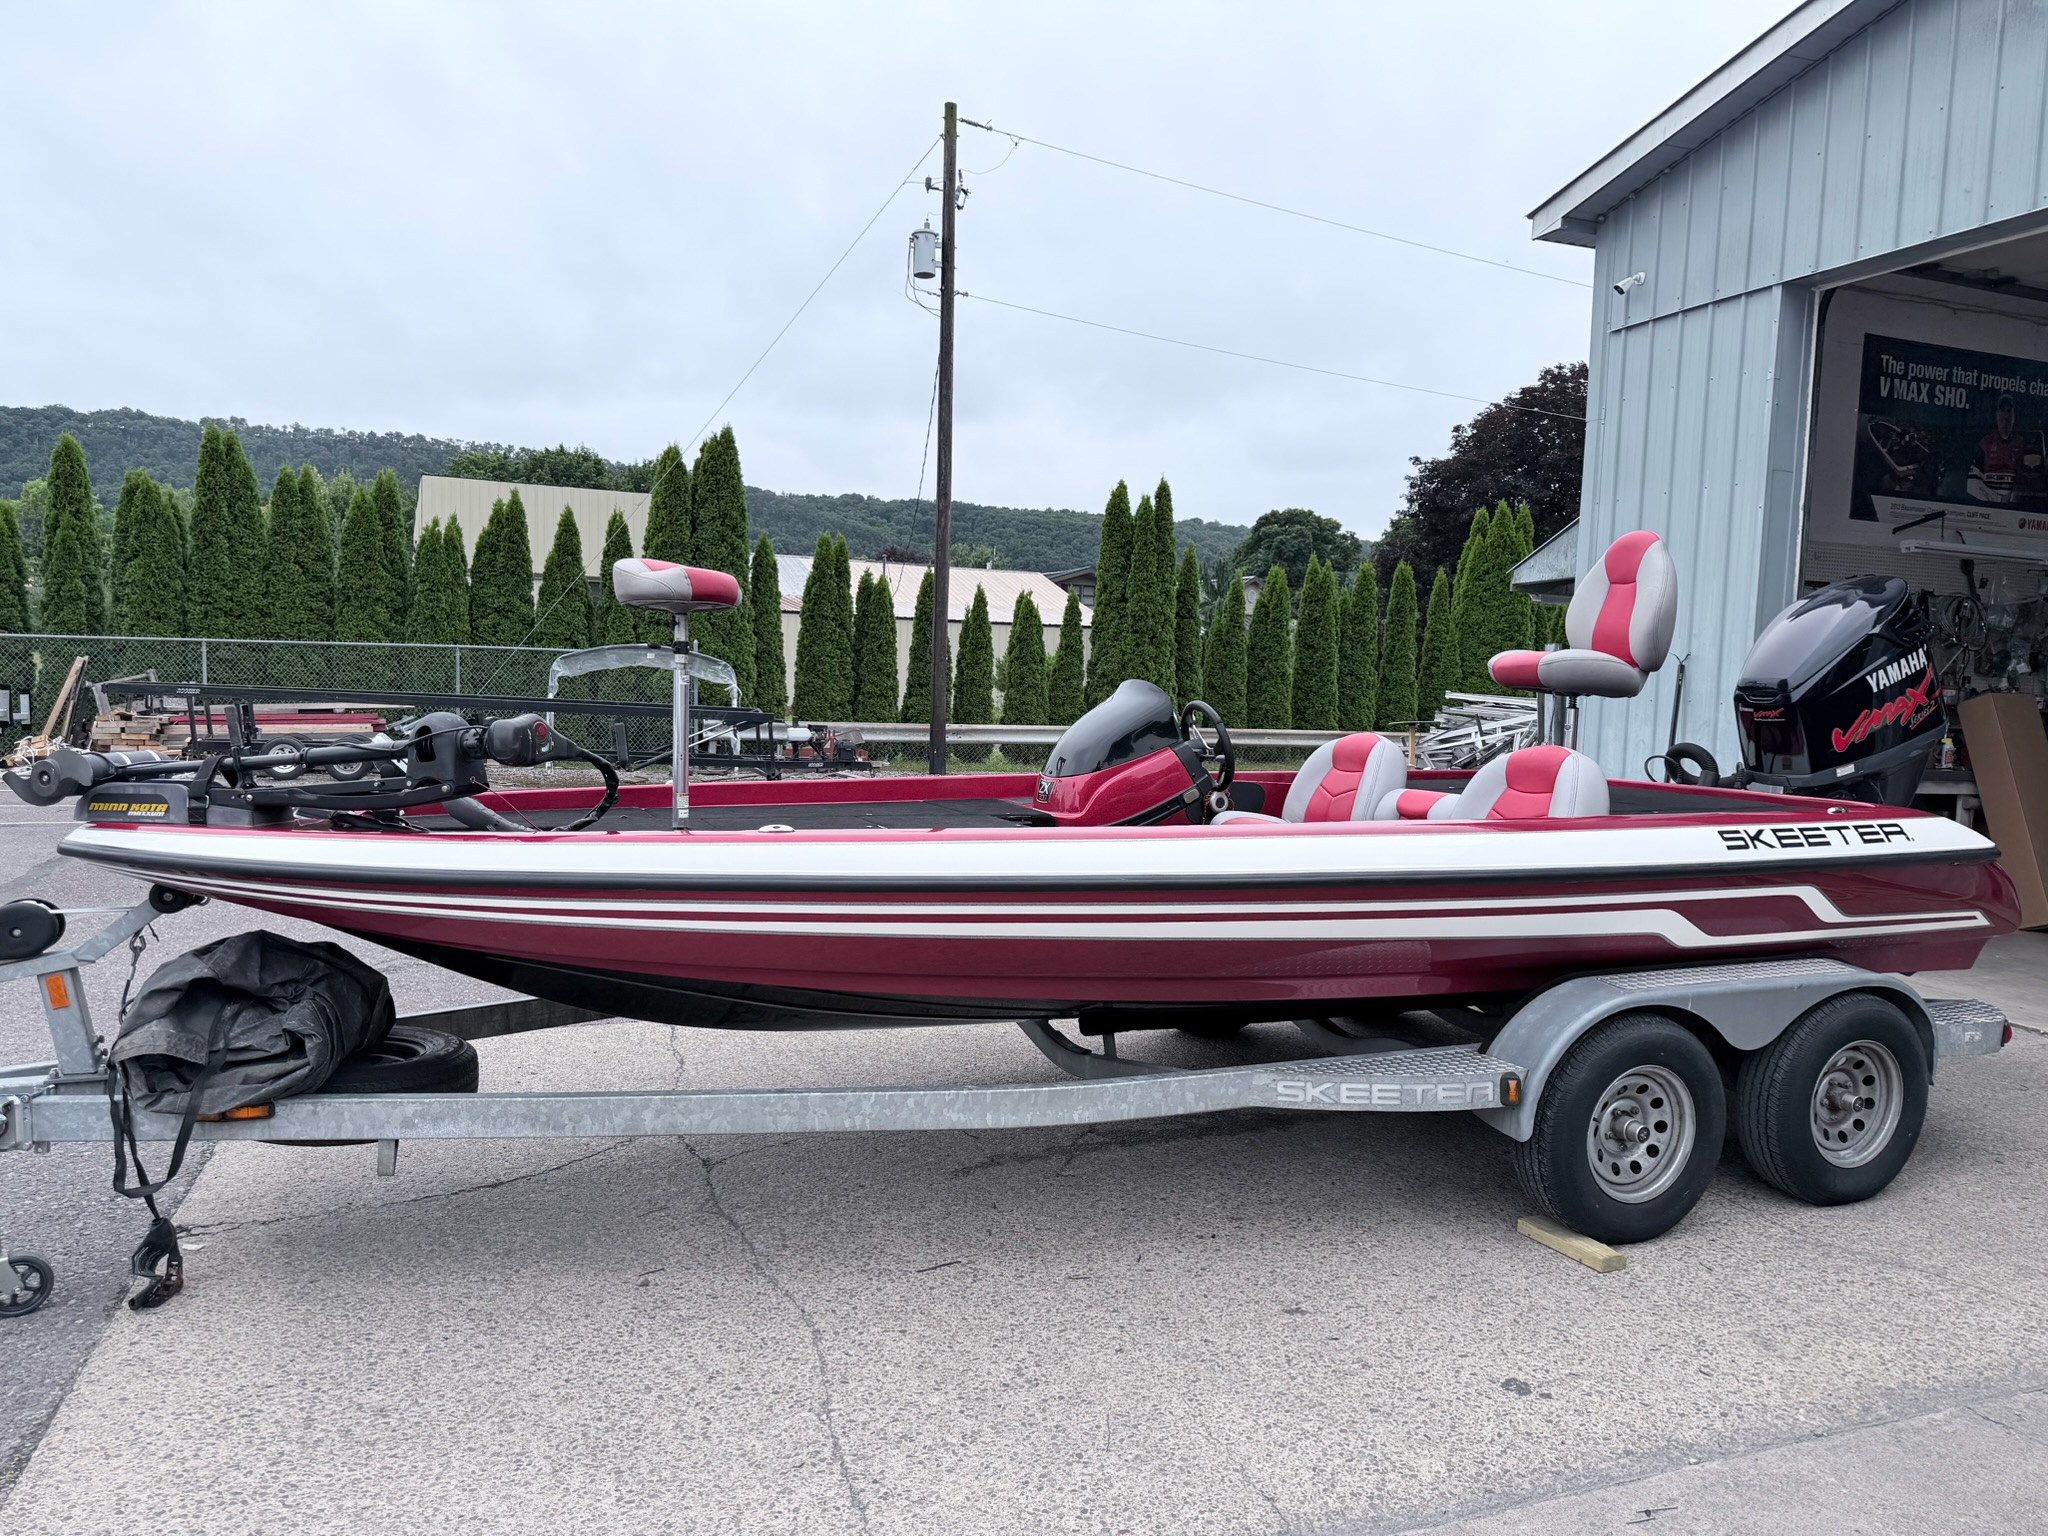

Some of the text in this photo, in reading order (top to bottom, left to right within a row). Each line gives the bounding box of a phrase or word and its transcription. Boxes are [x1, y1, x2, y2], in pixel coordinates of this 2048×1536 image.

[1881, 354, 1905, 375] The
[1908, 362, 1950, 381] power
[1952, 366, 1978, 386] that
[1980, 373, 2027, 394] propels
[1879, 376, 1970, 410] V MAX SHO.
[2027, 518, 2048, 531] YAMA
[1865, 647, 1927, 693] YAMAHA
[1039, 781, 1051, 794] ZX
[88, 802, 168, 812] MINN KOTA
[1717, 823, 1910, 851] SKEETER
[1276, 1080, 1494, 1105] SKEETER
